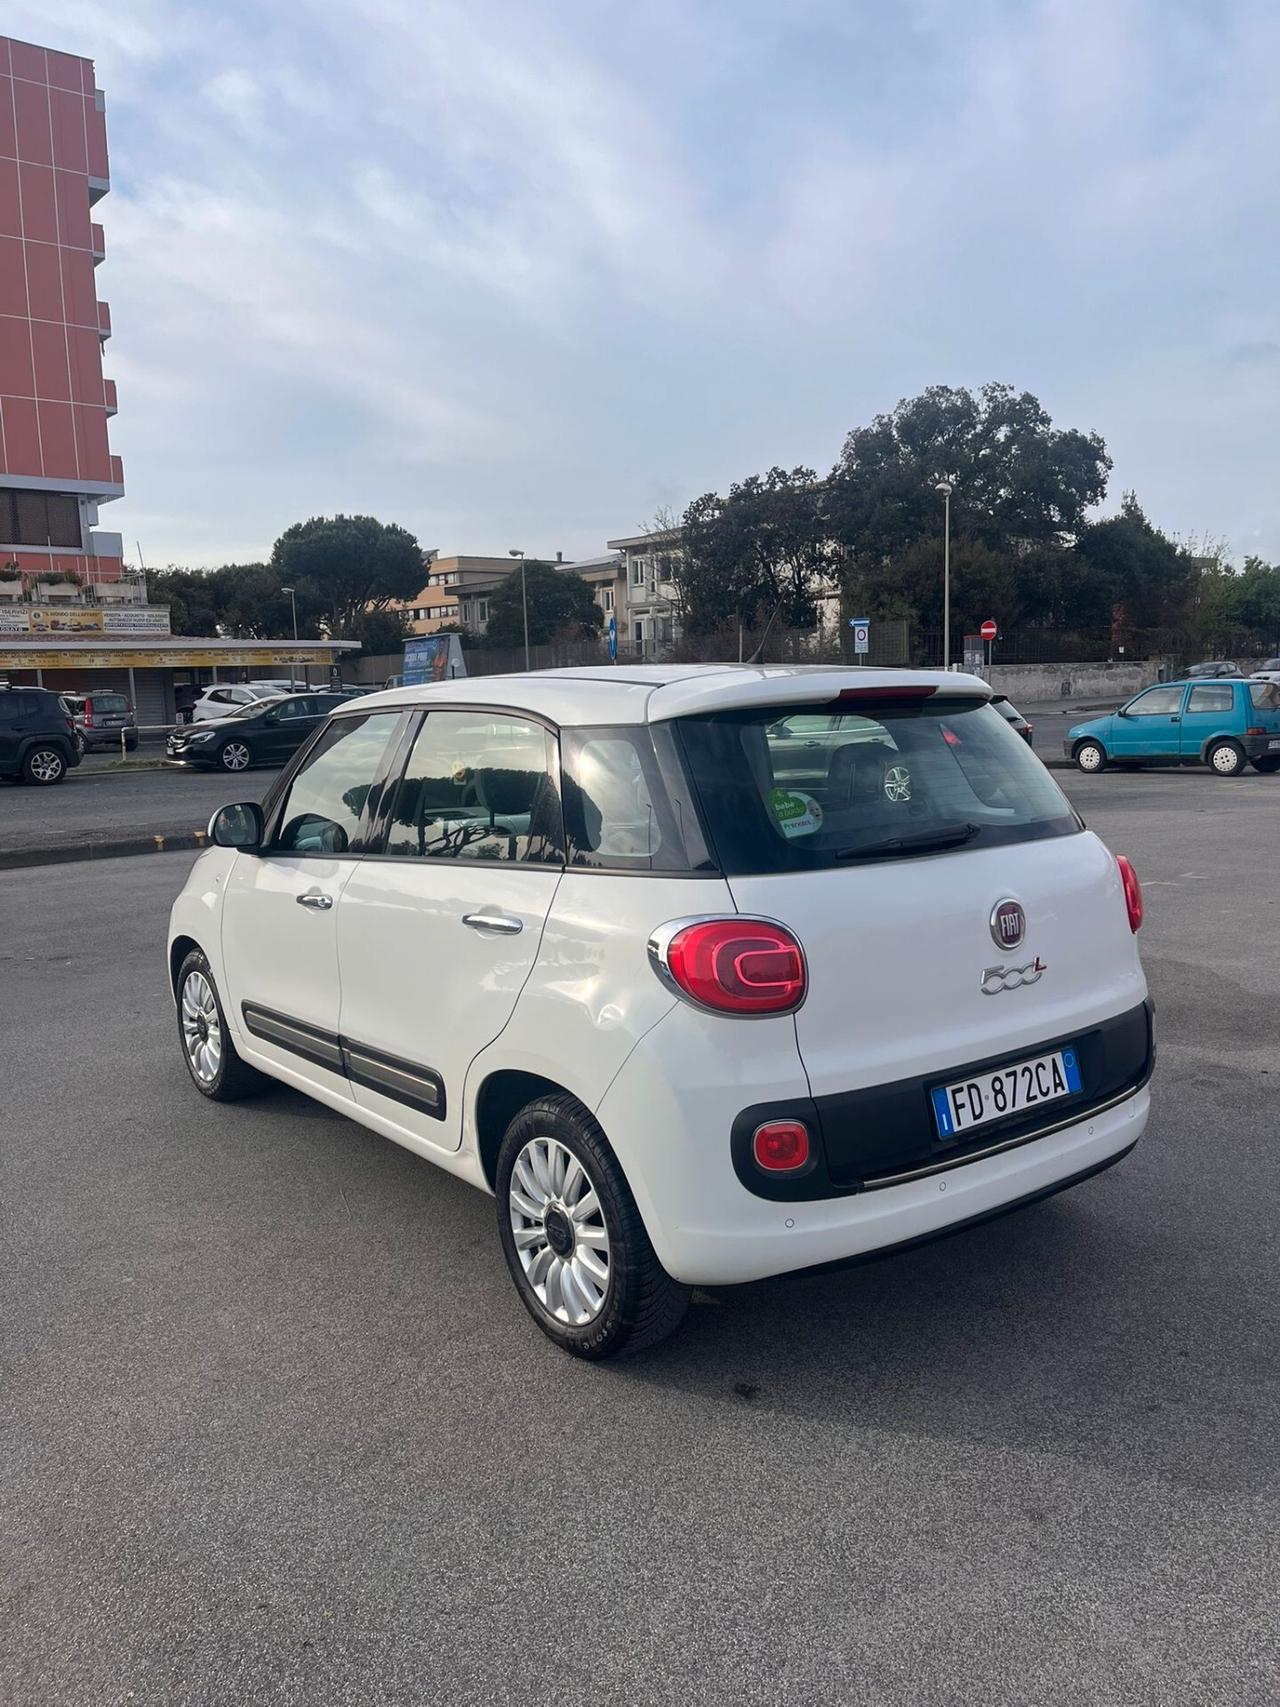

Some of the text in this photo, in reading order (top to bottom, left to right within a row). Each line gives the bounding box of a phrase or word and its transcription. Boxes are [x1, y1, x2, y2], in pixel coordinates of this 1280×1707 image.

[1000, 912, 1019, 937] FIAT
[951, 1058, 1065, 1126] FD 872CA
